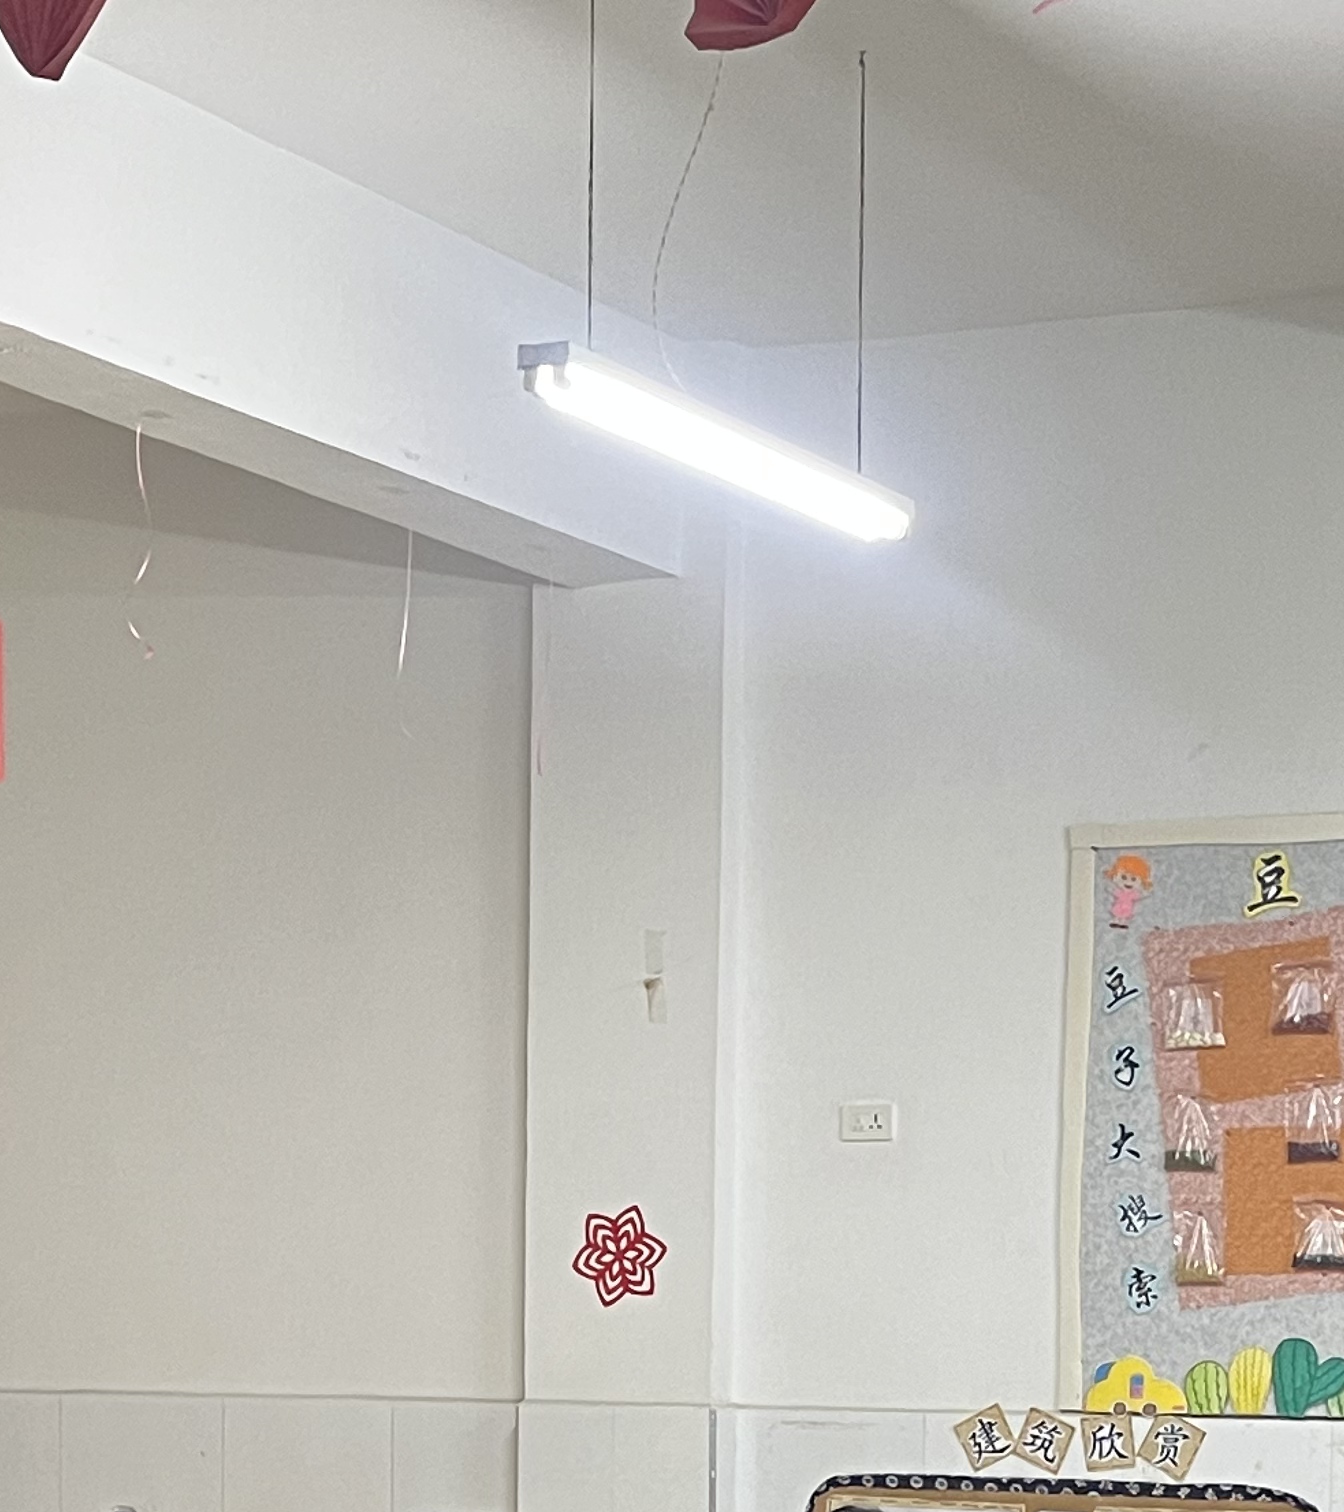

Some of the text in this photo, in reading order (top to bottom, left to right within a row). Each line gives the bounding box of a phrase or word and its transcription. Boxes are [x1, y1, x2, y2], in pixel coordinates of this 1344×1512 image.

[1103, 966, 1160, 1309] 豆子大搜索
[969, 1417, 1189, 1467] 建筑欣赏
